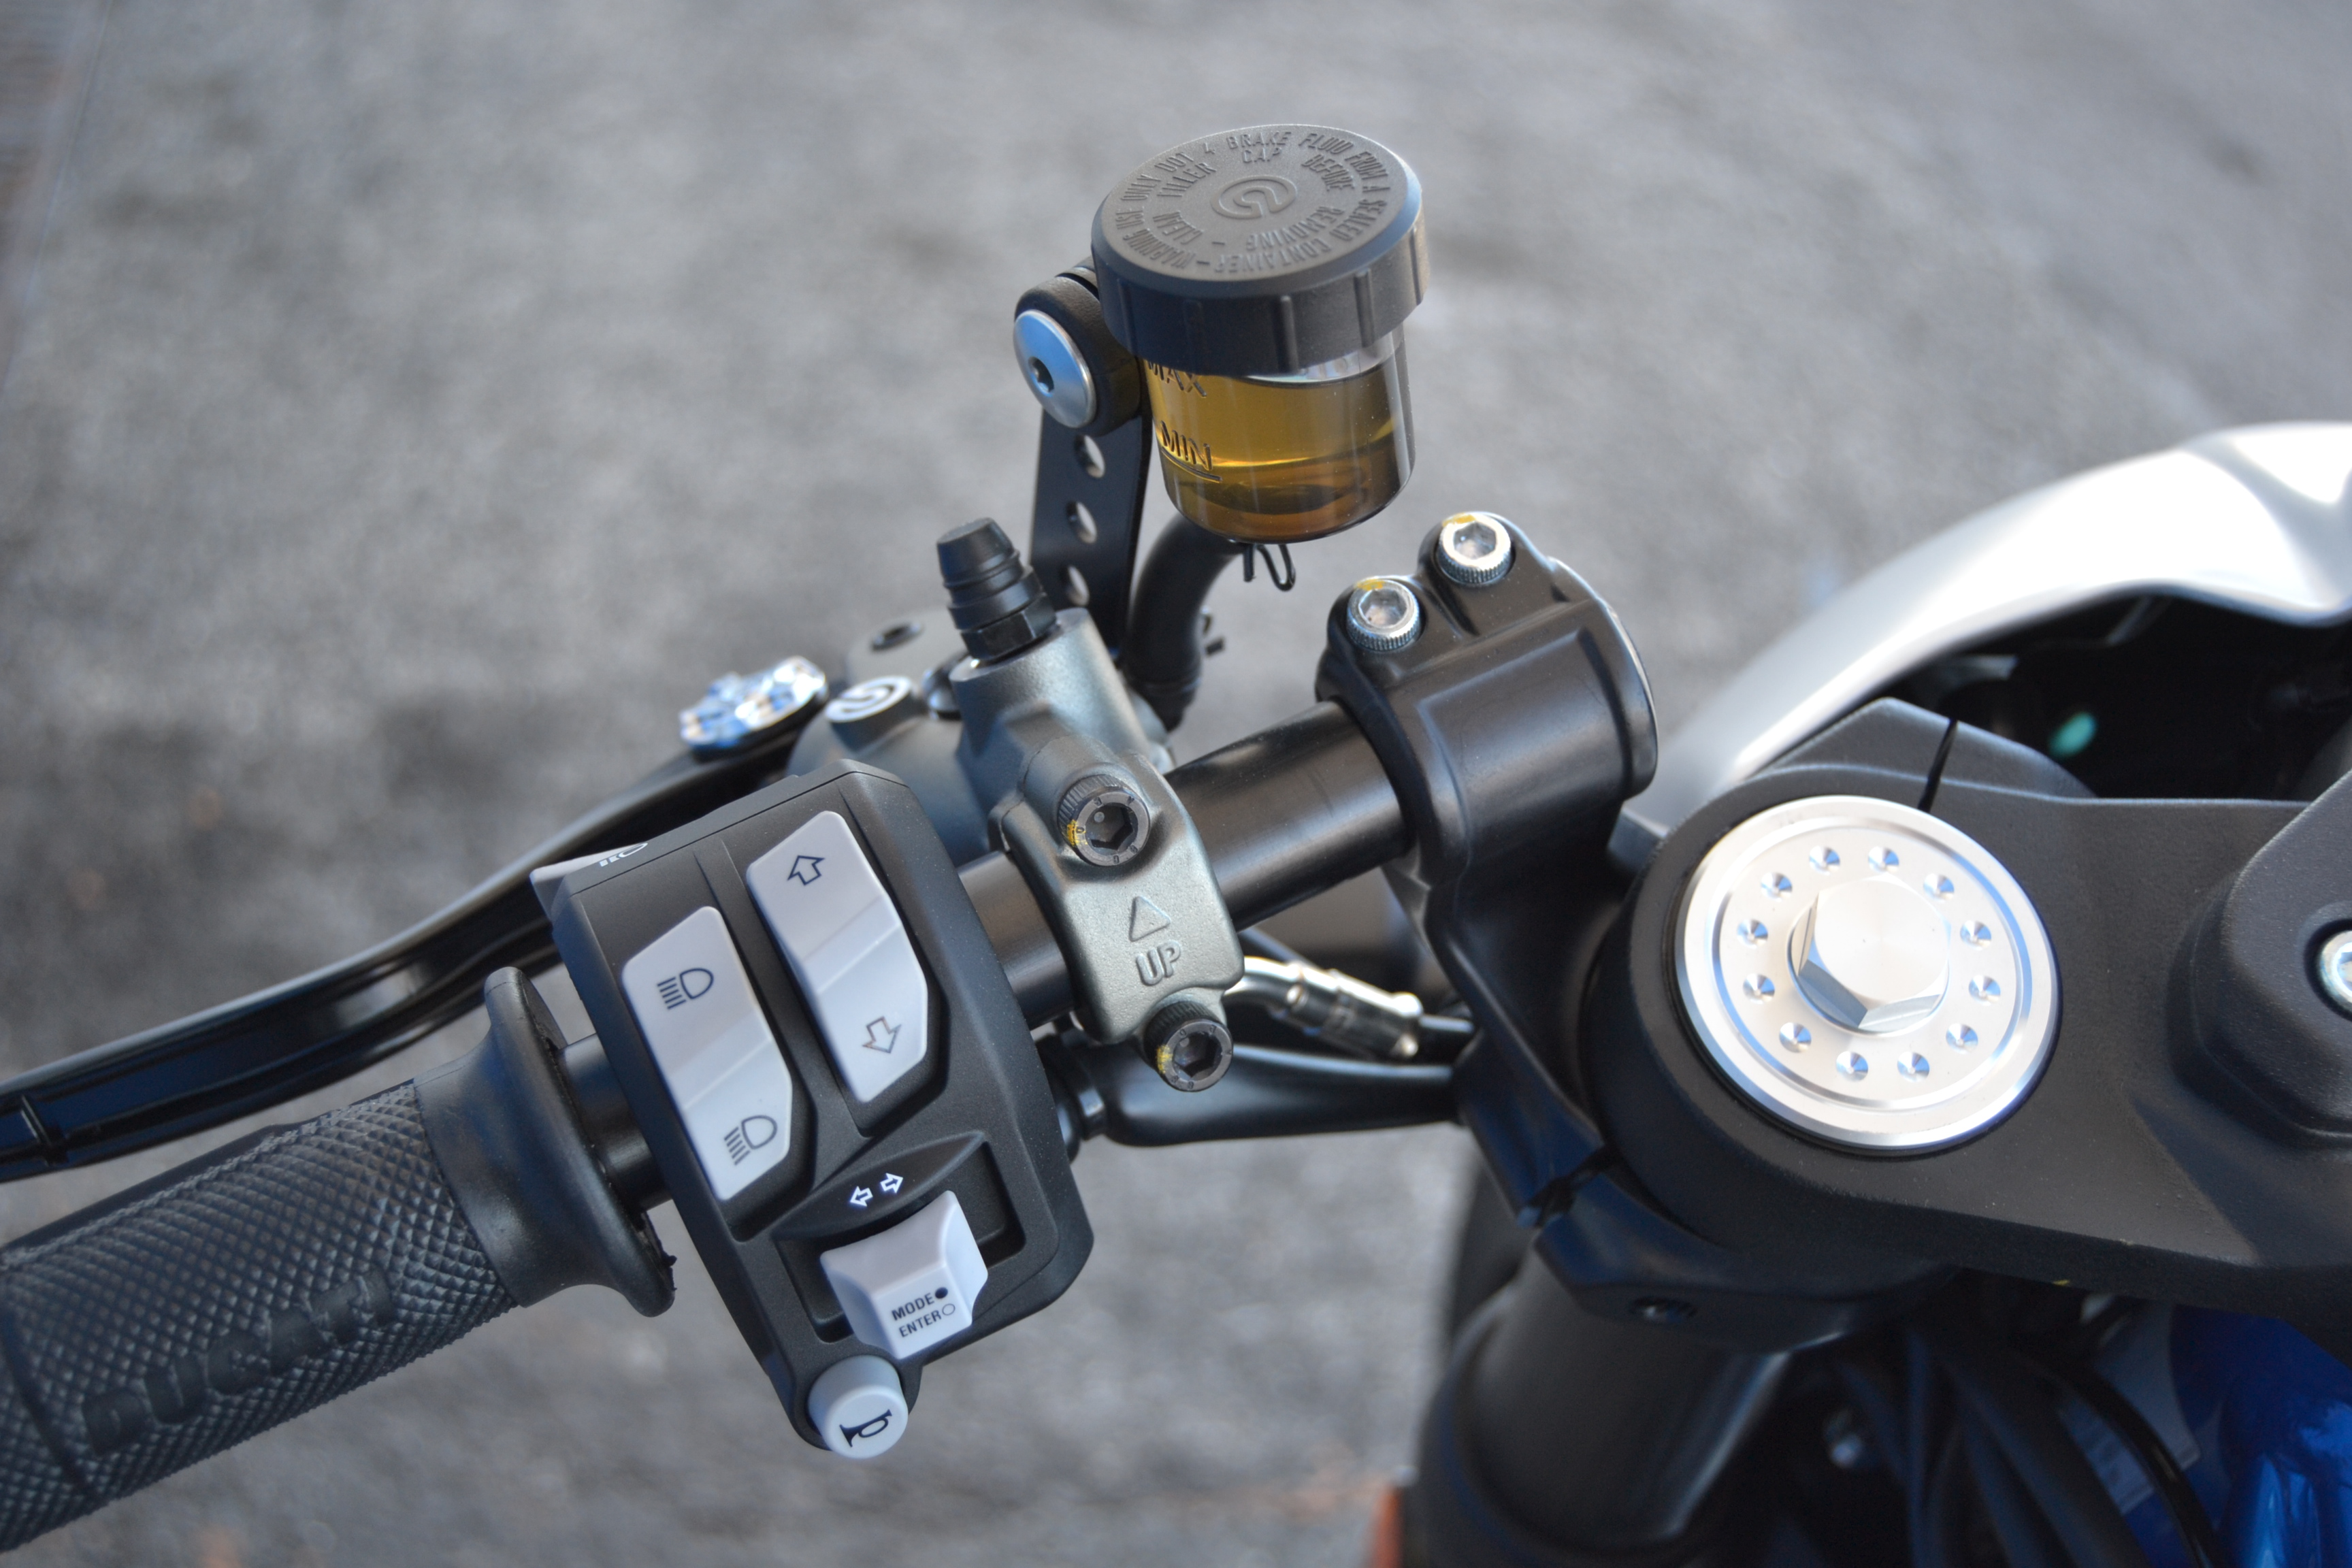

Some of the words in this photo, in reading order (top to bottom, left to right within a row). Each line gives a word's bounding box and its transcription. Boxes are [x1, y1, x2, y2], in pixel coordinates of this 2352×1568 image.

[1204, 142, 1215, 154] 4
[1227, 132, 1292, 149] BRAKE
[1242, 147, 1282, 163] CAP
[1298, 133, 1354, 154] FLUID
[1154, 152, 1194, 172] DOT
[1301, 154, 1355, 191] BEFORE
[1344, 151, 1389, 180] FROM
[1121, 174, 1161, 200] ONLY
[1157, 163, 1217, 197] FILLER
[1115, 207, 1145, 229] USE
[1152, 210, 1205, 245] CLEAN
[1246, 206, 1345, 251] REMOVING
[1329, 198, 1387, 242] SEALED
[1123, 228, 1196, 269] WARNING
[1214, 238, 1332, 273] CONTAINER
[1160, 421, 1213, 470] MIN
[1135, 940, 1181, 986] UP
[891, 1293, 935, 1321] MODE
[898, 1309, 942, 1338] ENTER
